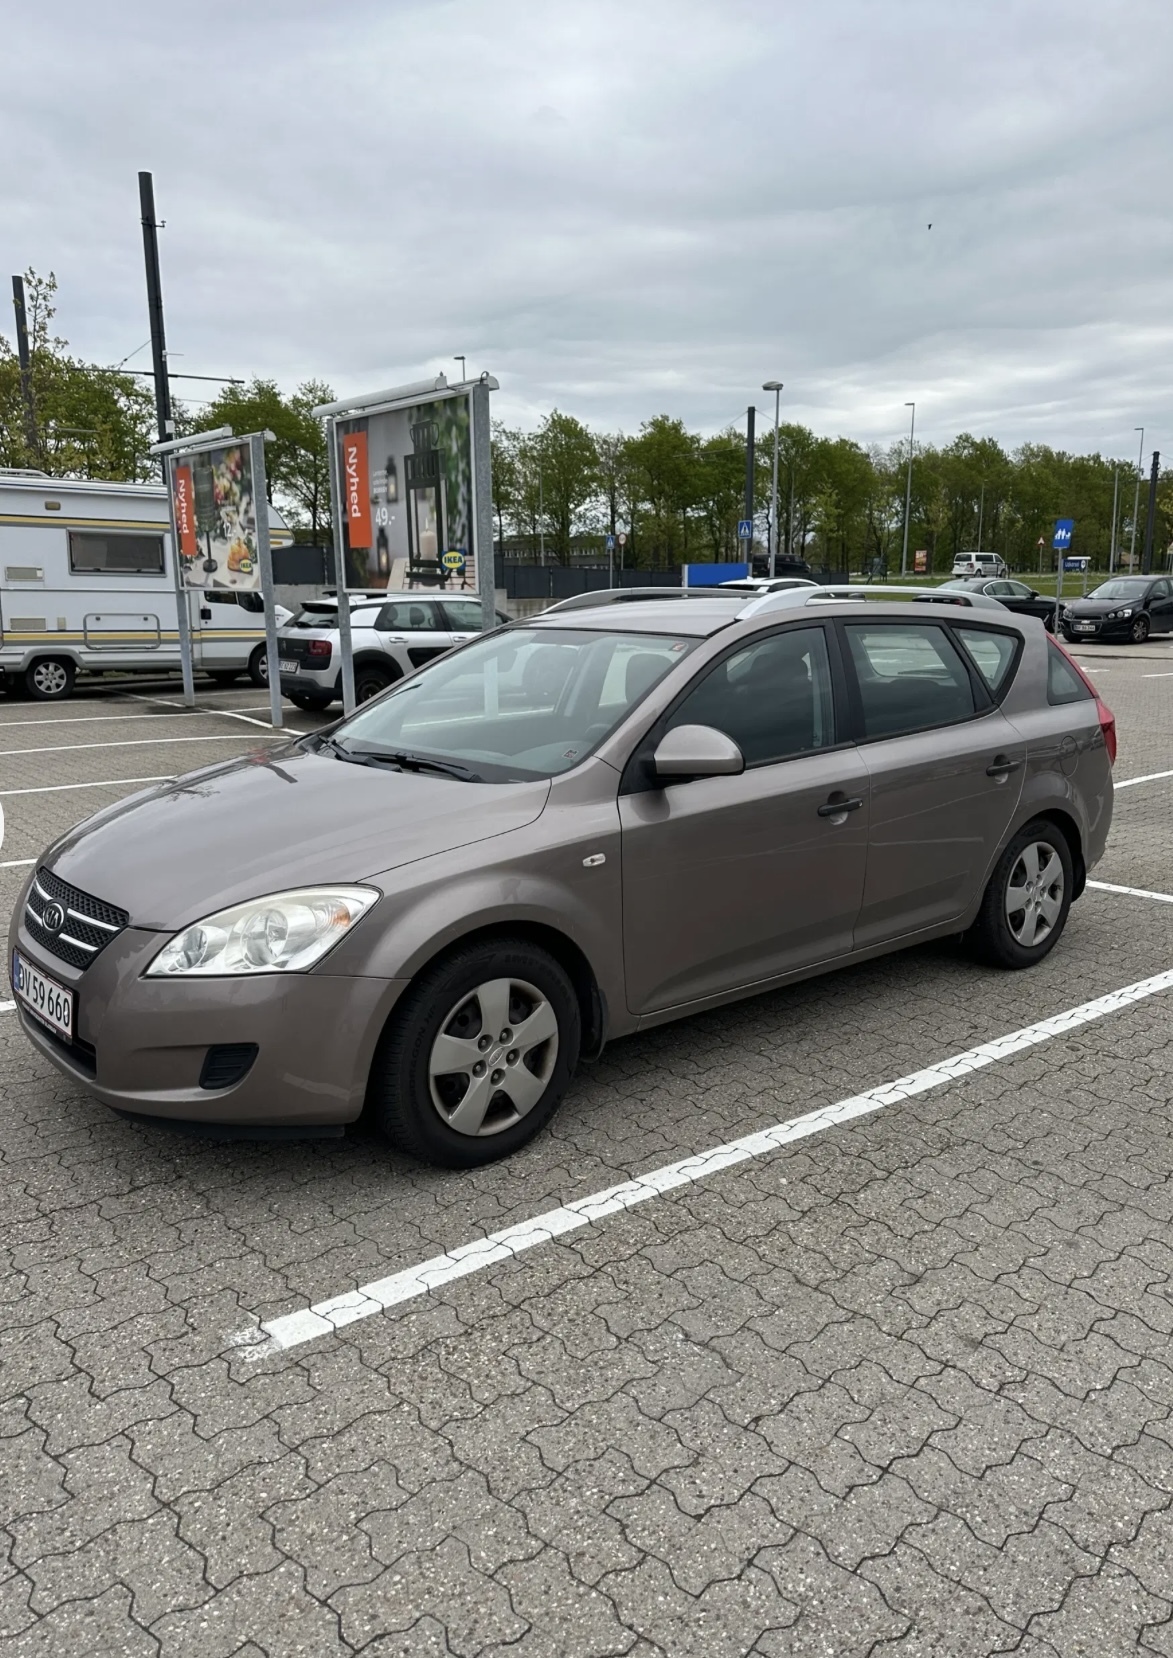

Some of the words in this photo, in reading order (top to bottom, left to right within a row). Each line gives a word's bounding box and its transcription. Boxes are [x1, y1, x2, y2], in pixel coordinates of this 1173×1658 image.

[178, 480, 189, 533] Nyhed
[347, 447, 361, 517] Nyhed
[444, 555, 463, 564] IKEA
[45, 907, 59, 928] KIA
[33, 976, 45, 1009] 59
[48, 987, 70, 1027] 660
